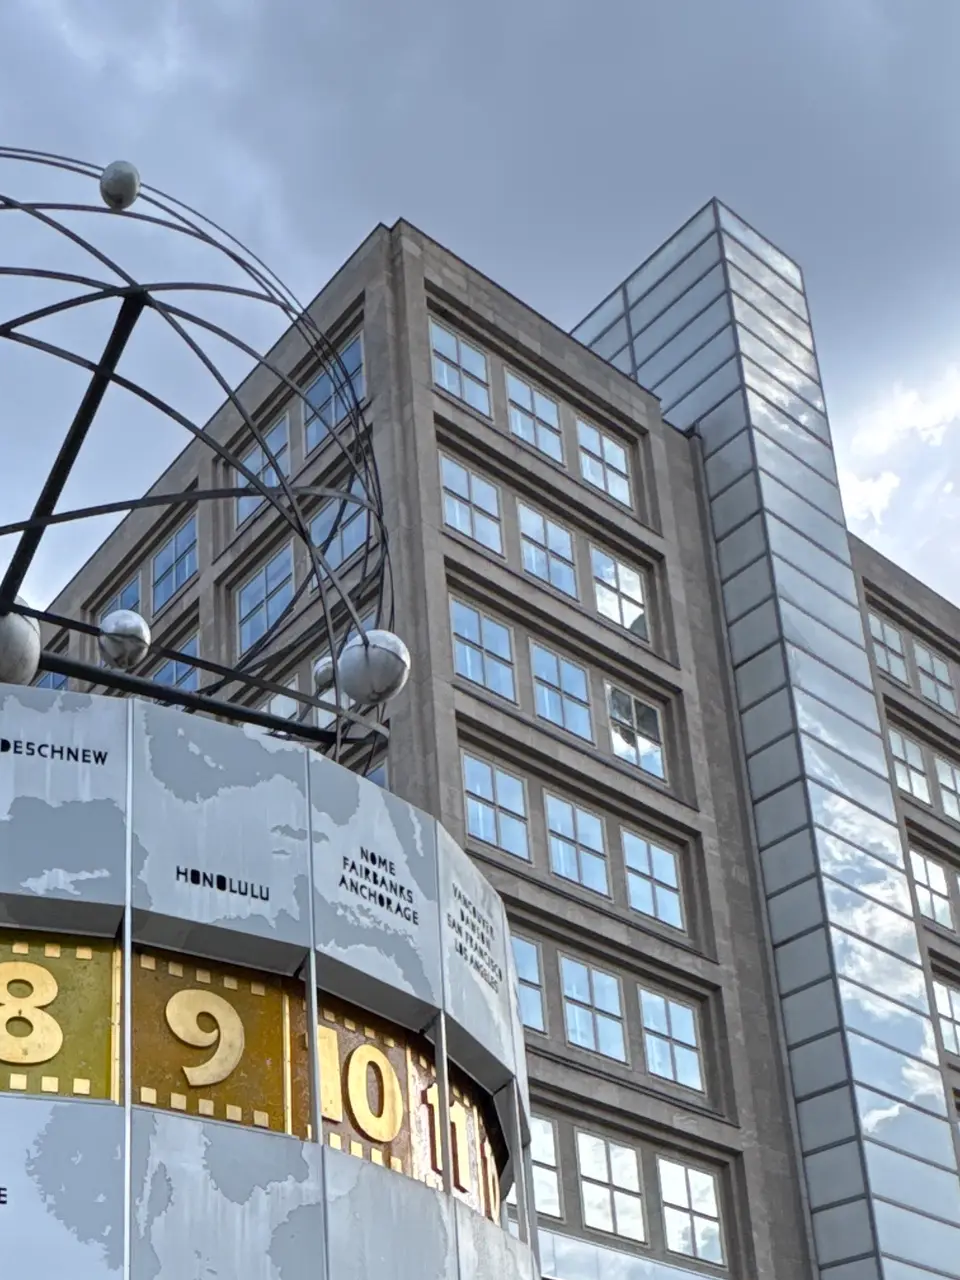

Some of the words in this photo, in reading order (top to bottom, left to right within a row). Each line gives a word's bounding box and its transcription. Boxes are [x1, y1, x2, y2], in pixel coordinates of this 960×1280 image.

[0, 738, 108, 766] DESCHNEW
[342, 856, 414, 904] FAIRBANKS
[360, 846, 396, 876] NOME
[176, 865, 270, 902] HONOLULU
[339, 875, 420, 926] ANCHORAGE
[165, 988, 246, 1087] 9
[317, 1024, 404, 1143] 10
